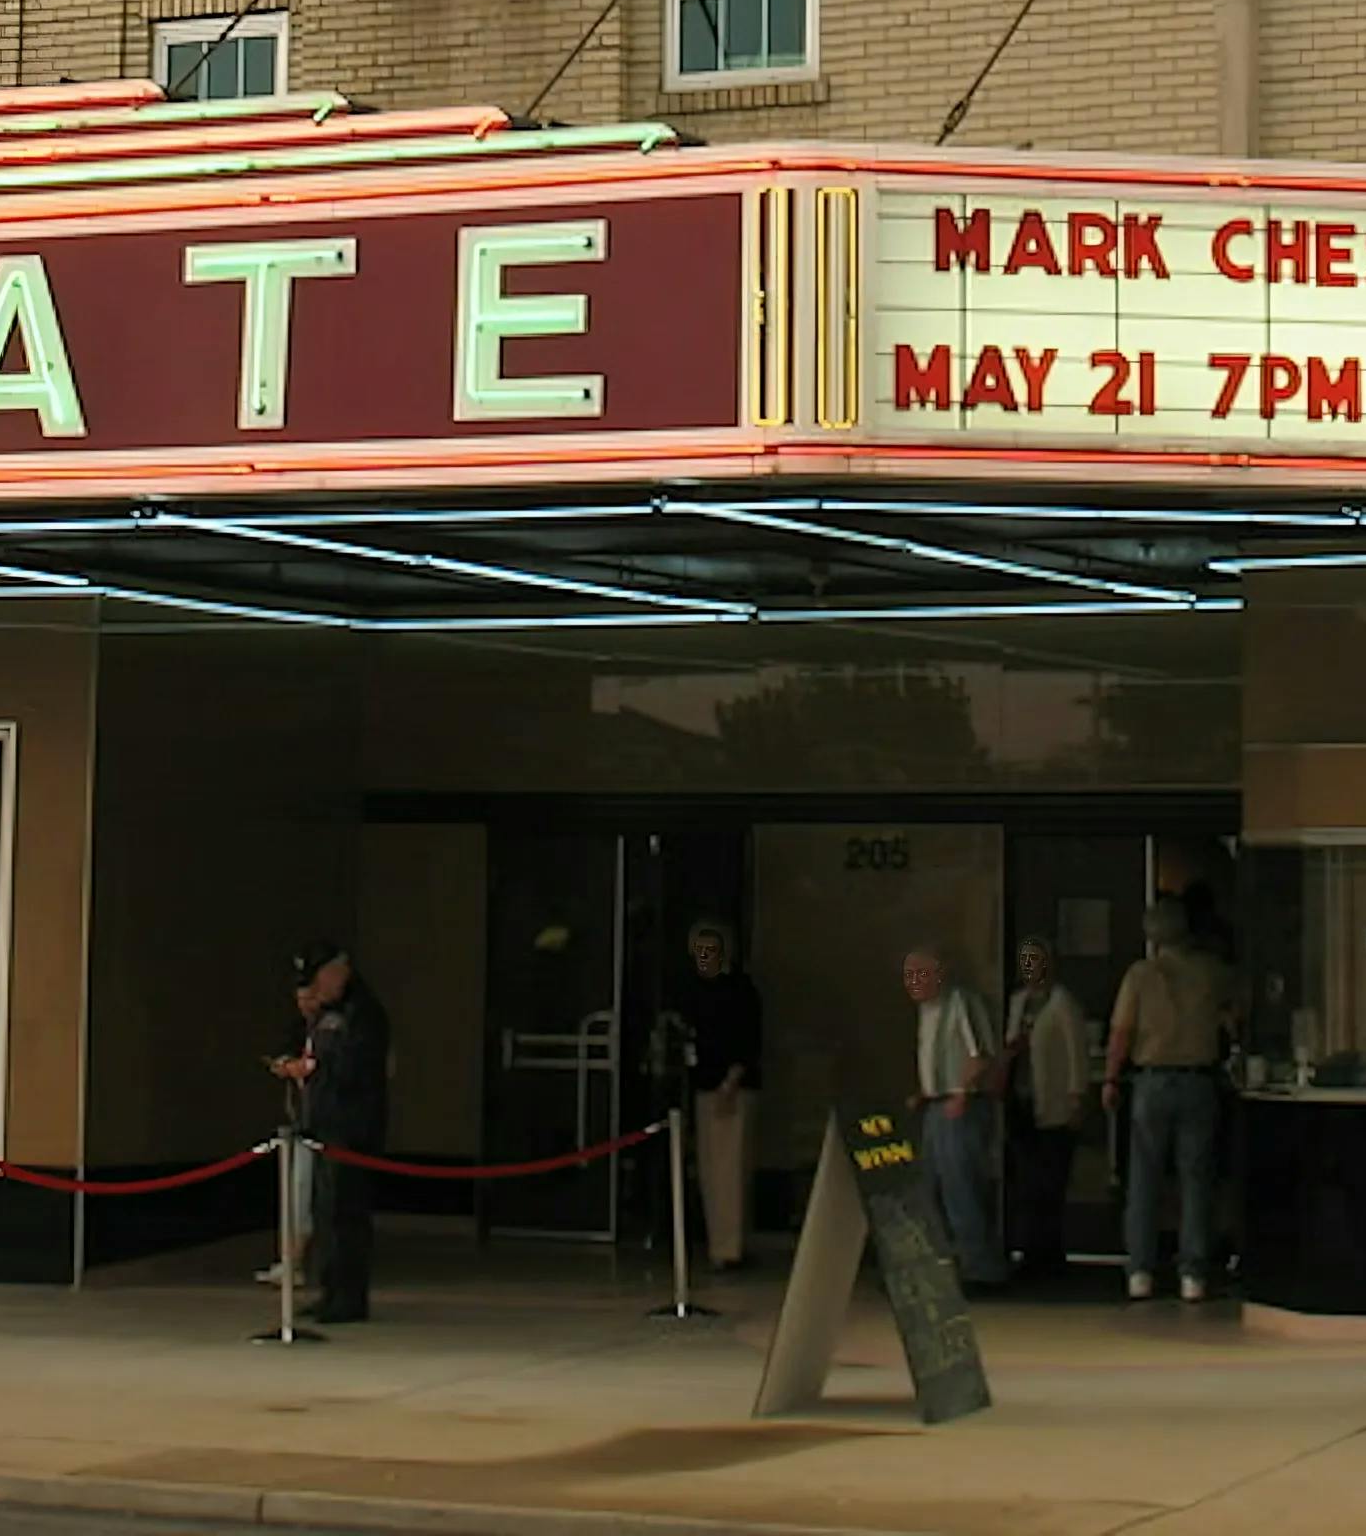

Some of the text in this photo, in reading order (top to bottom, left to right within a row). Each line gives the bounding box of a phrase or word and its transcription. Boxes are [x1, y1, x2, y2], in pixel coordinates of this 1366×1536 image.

[934, 207, 1170, 280] MARK
[893, 343, 1059, 413] MAY
[1087, 349, 1156, 417] 21
